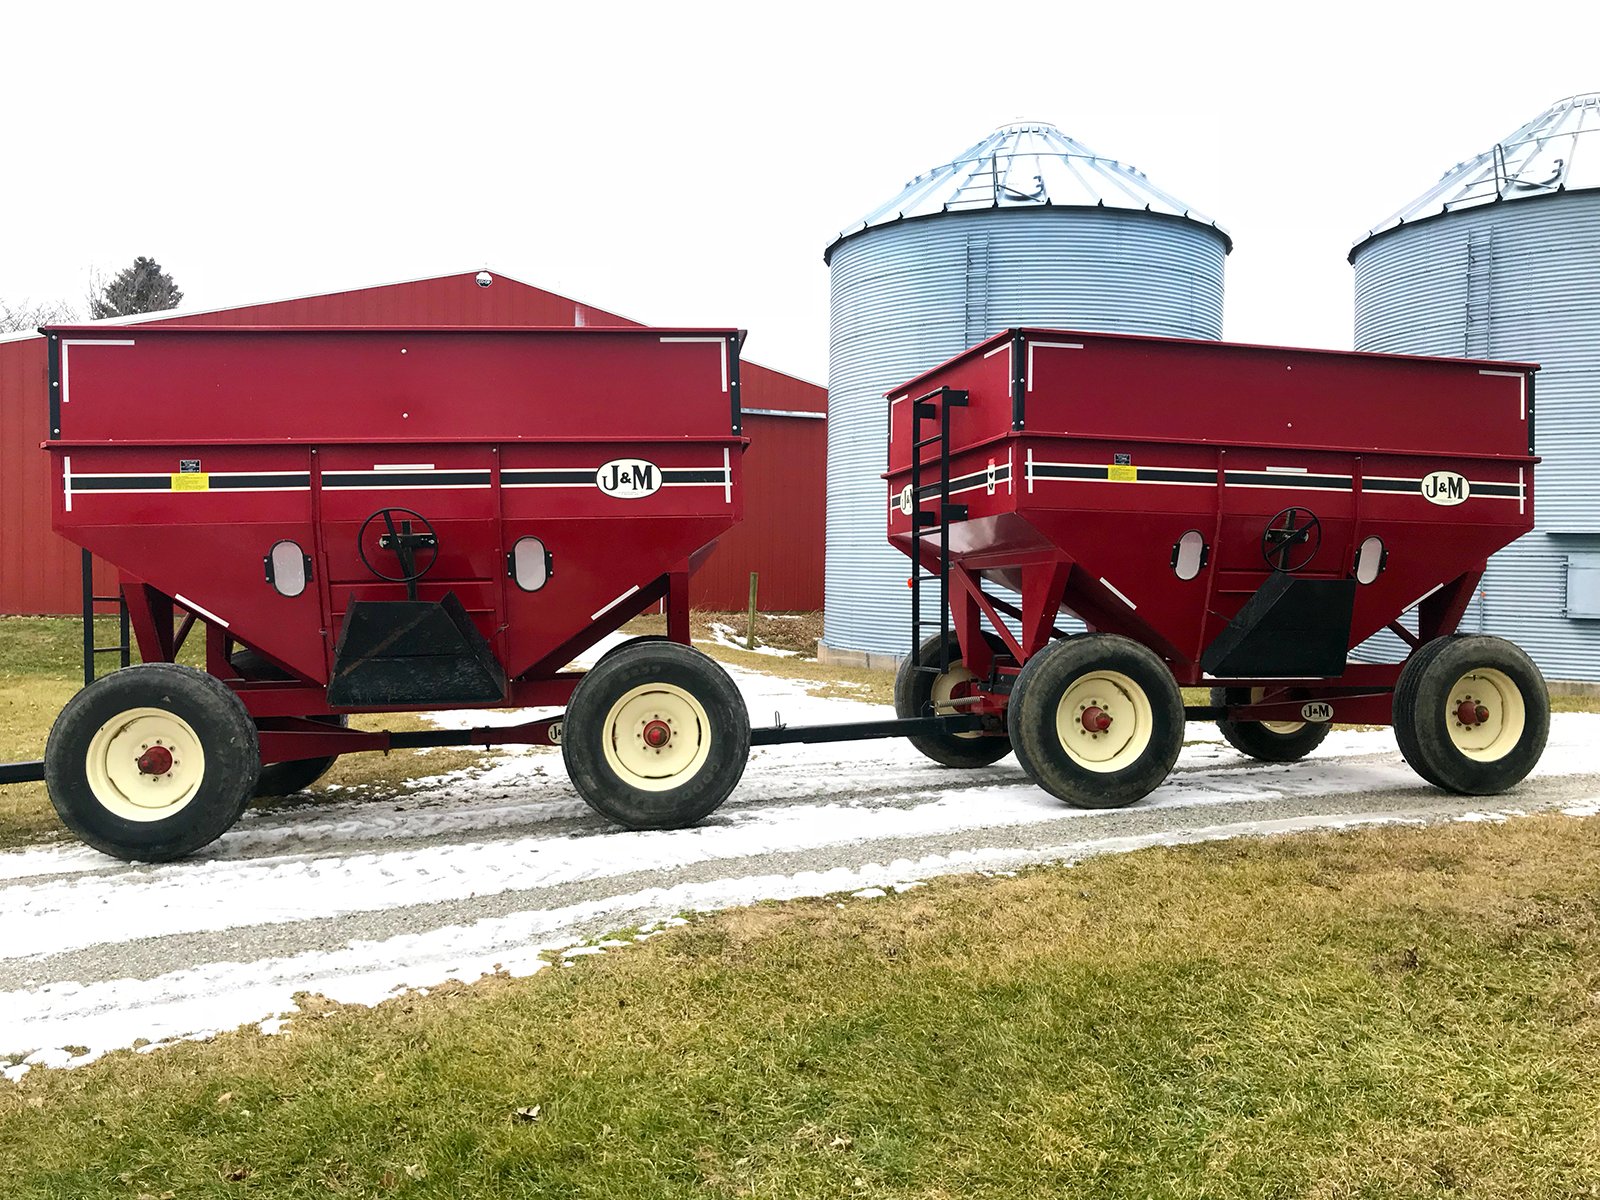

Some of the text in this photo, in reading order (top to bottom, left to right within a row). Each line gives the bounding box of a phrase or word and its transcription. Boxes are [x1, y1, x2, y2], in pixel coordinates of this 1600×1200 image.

[602, 465, 654, 491] J&M
[1425, 476, 1464, 500] J&M
[901, 488, 913, 511] J&
[1304, 705, 1330, 718] J&M
[550, 725, 562, 740] J&
